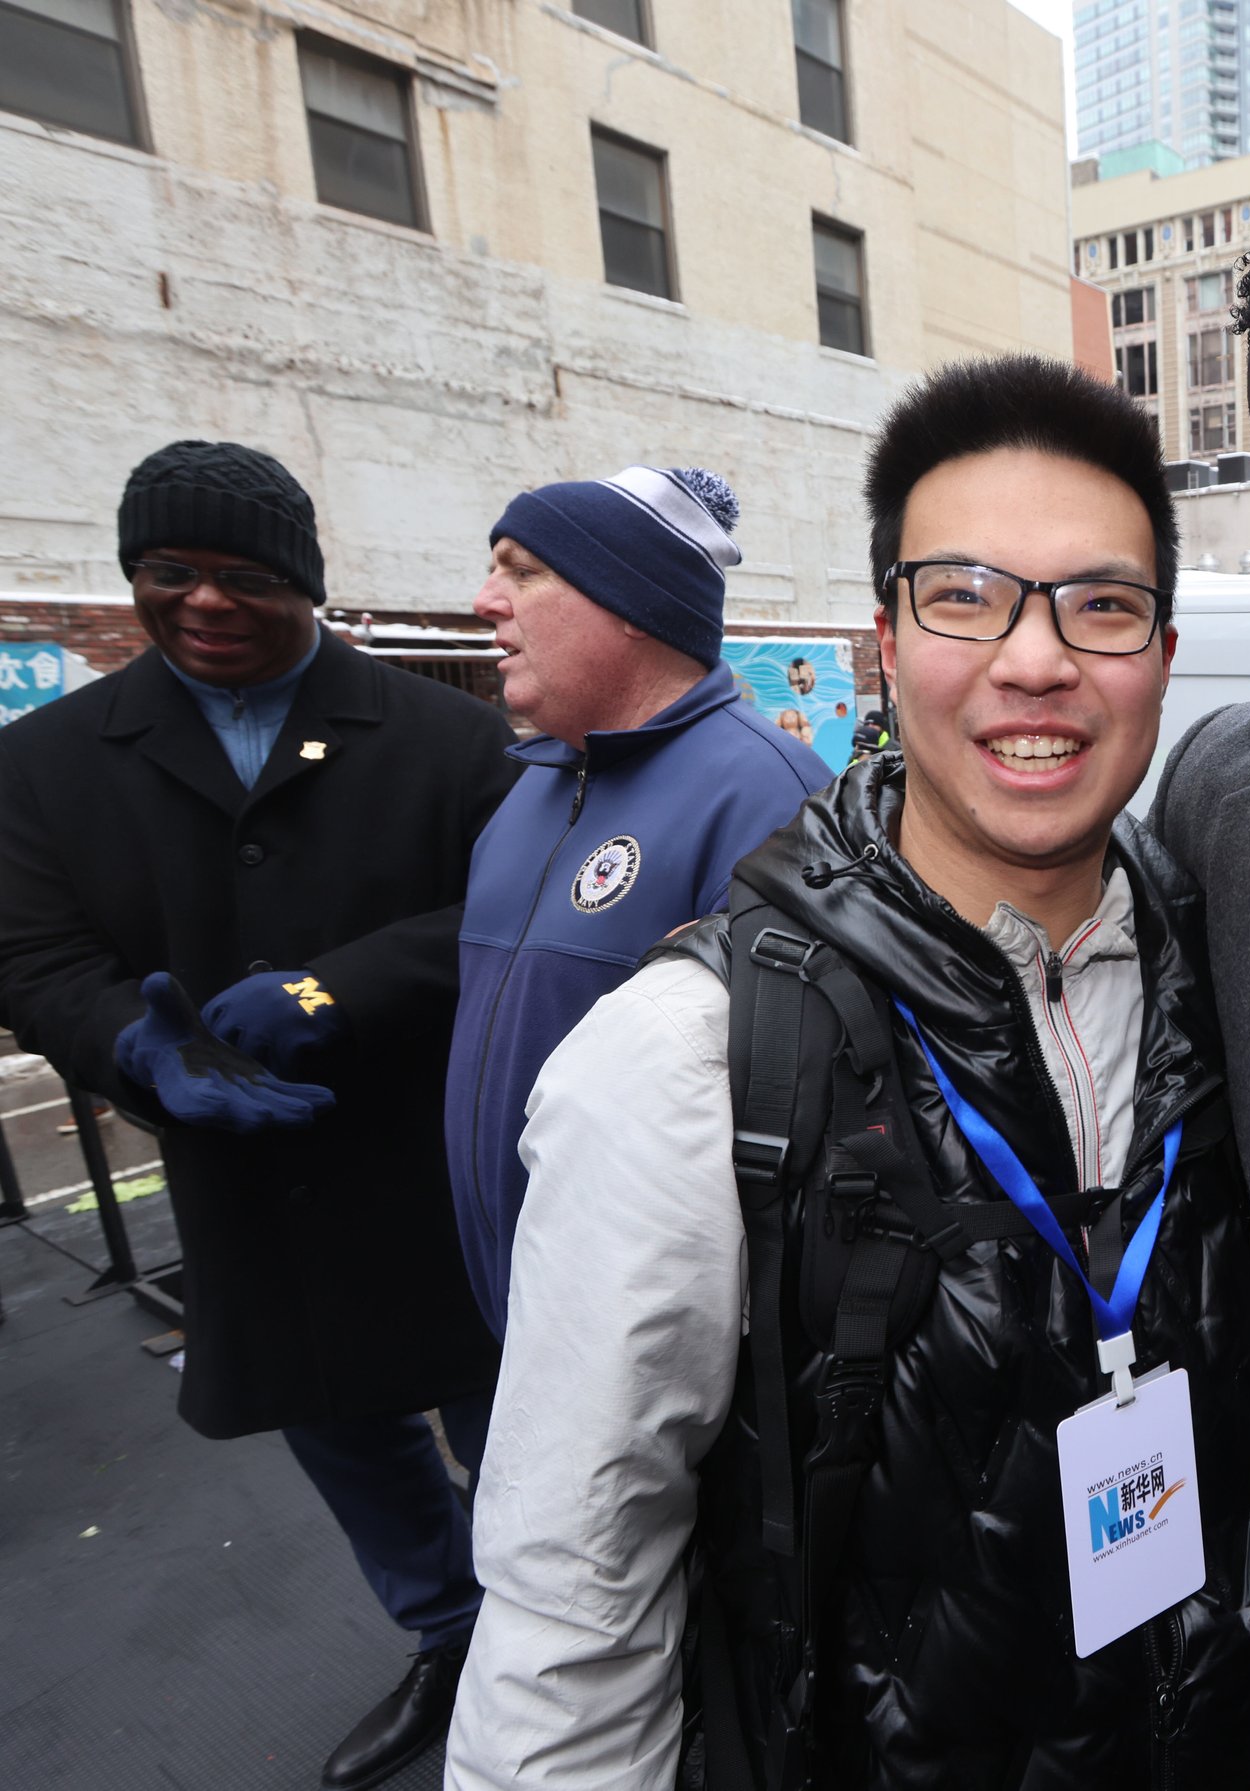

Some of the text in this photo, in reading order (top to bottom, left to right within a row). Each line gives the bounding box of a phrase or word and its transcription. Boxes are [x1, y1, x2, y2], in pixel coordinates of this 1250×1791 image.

[577, 896, 600, 909] NAVY
[282, 977, 335, 1016] M
[1087, 1452, 1163, 1494] www.news.cn
[1121, 1465, 1165, 1512] 新华网
[1088, 1487, 1145, 1553] NEWS
[1093, 1518, 1169, 1563] www.xinhuanetcom
